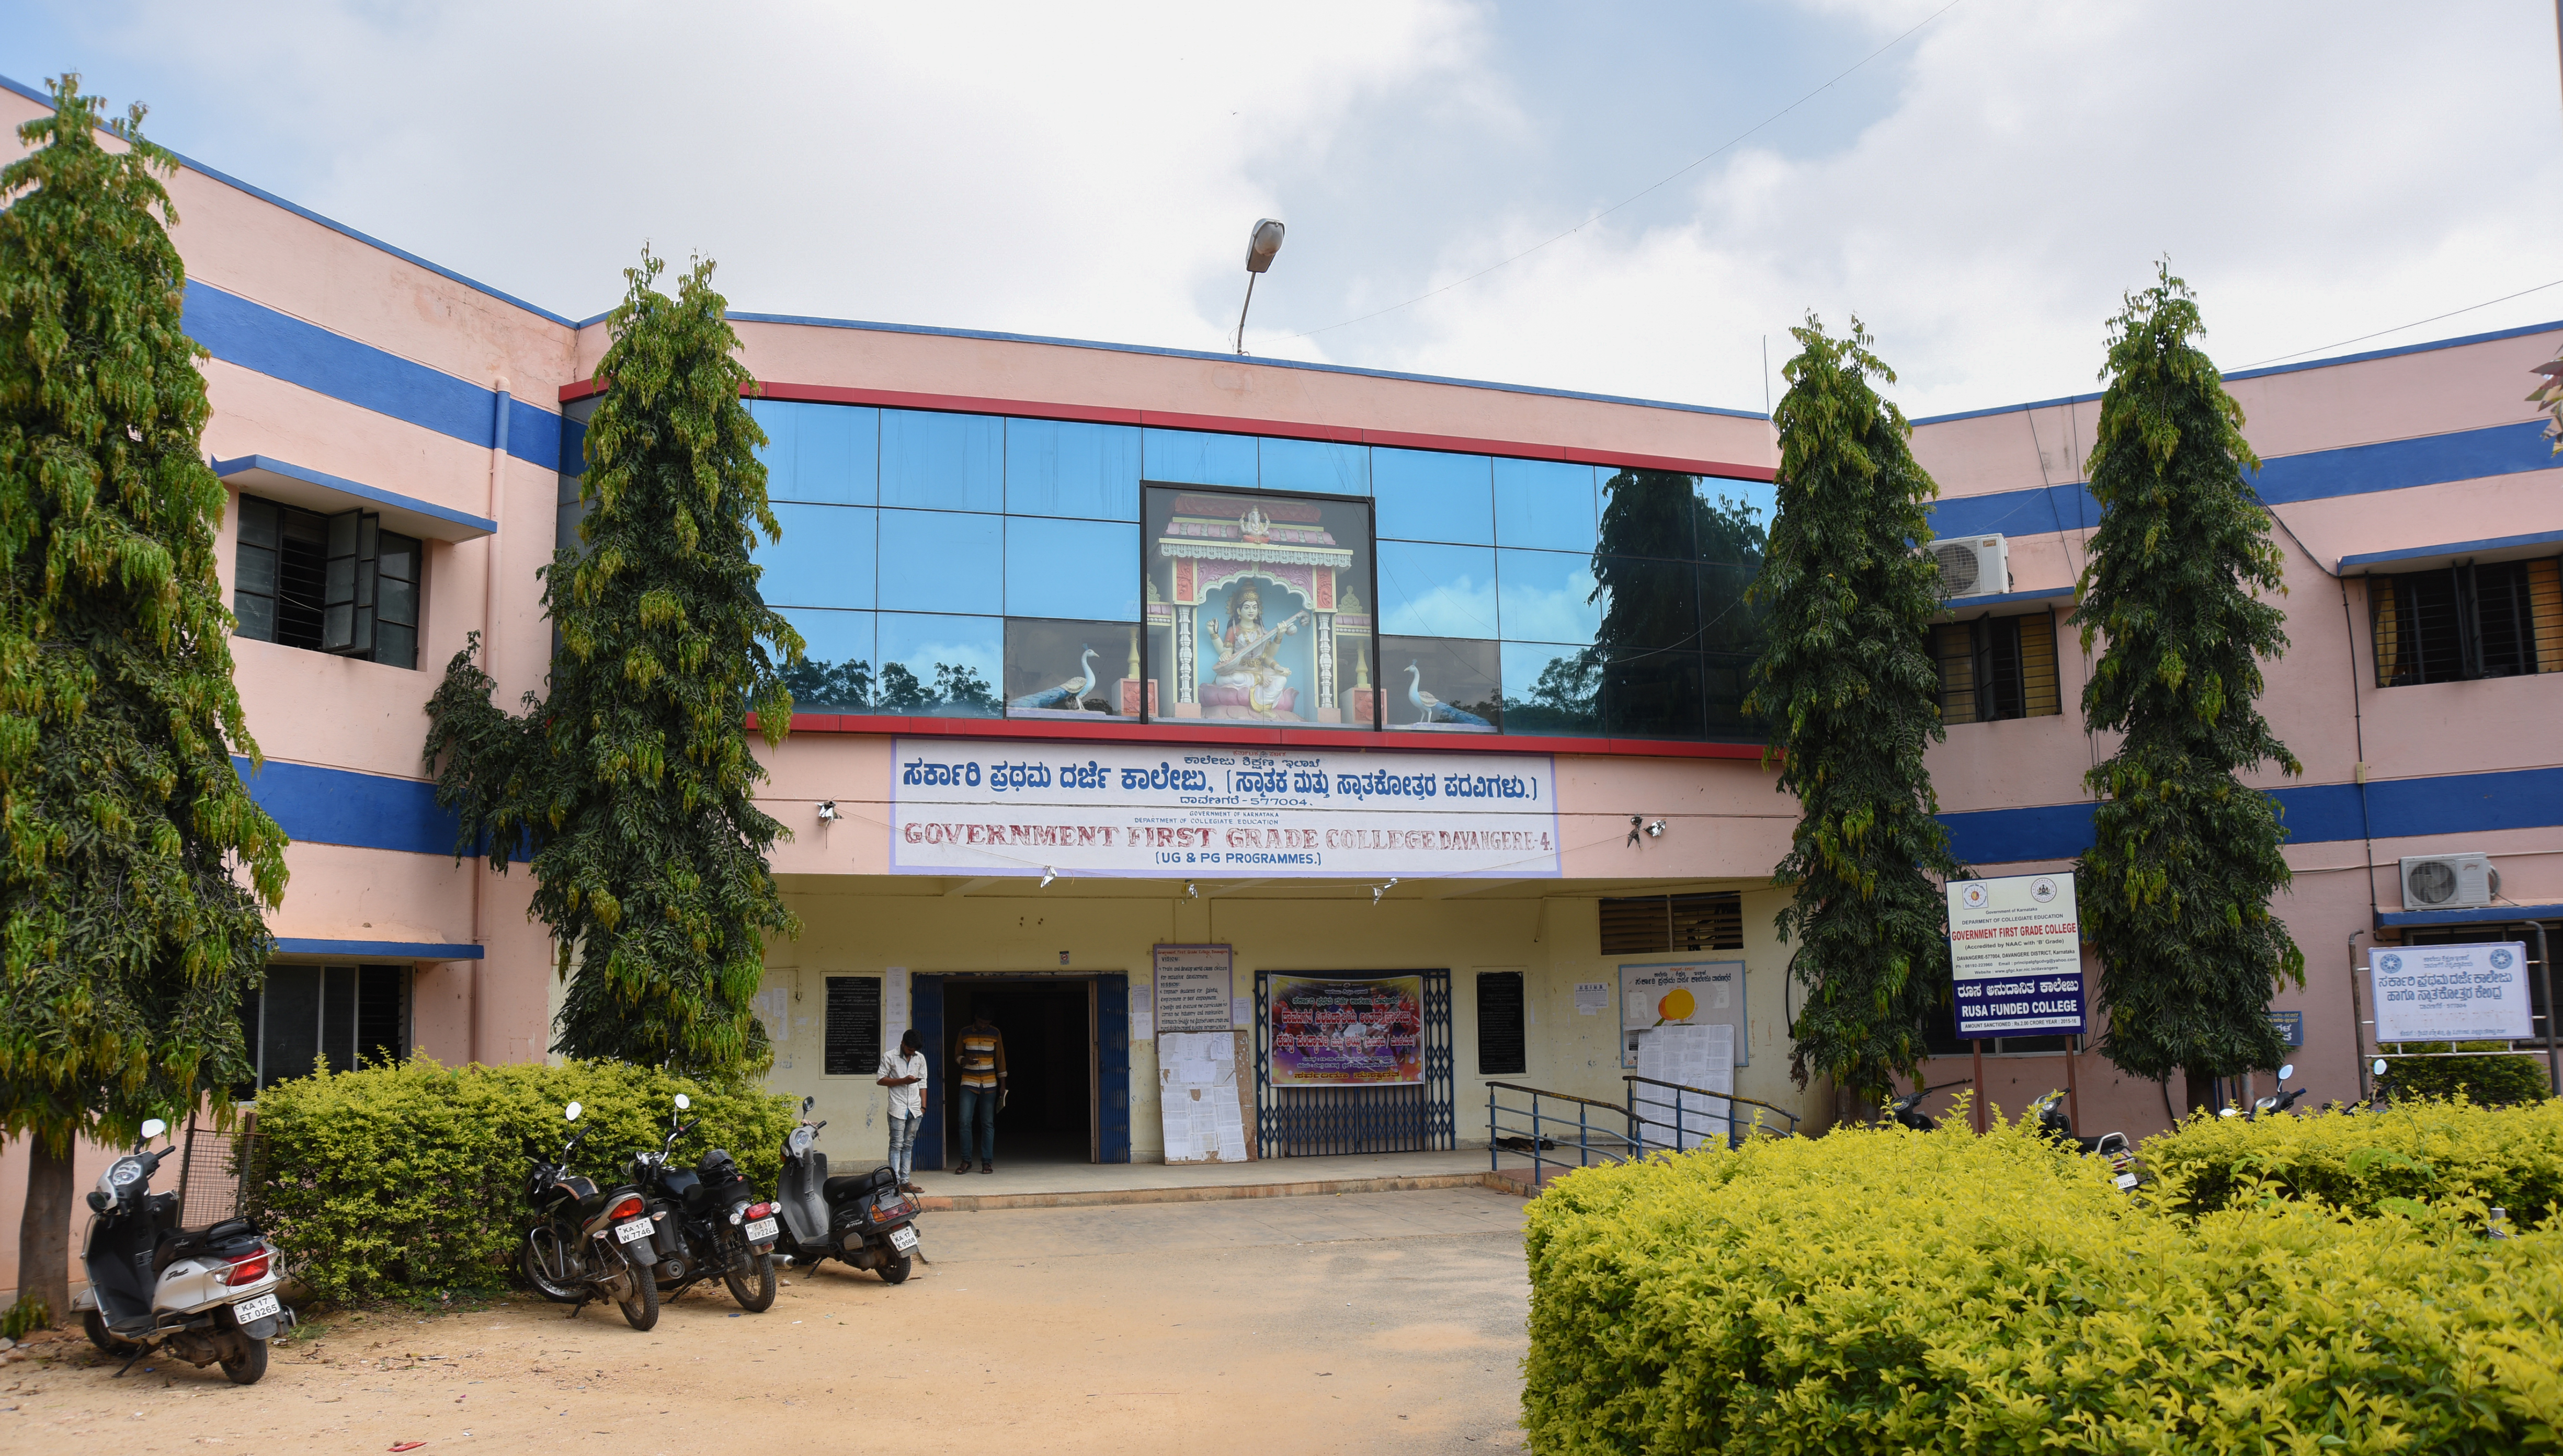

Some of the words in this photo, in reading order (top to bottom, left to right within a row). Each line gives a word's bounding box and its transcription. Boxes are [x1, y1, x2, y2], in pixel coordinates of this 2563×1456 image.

[1184, 755, 1235, 765] ಕಾಲೇಜು
[1243, 756, 1274, 769] ಶಿಕ್ಷಣ
[1282, 759, 1320, 768] ಇಲಾಖೆ
[903, 757, 981, 787] ಸರ್ಕಾರಿ
[990, 760, 1052, 792] ಪ್ರಥಮ
[1060, 761, 1111, 788] ದರ್ಜೆ
[1121, 762, 1213, 793] ಕಾಲೇಜು,
[1294, 769, 1330, 798] ಮತ್ತು
[1337, 769, 1437, 801] ಸ್ನಾತಕೋತ್ತರ
[904, 822, 1120, 847] GOVERNMENT
[1126, 826, 1217, 848] FIRST
[1225, 827, 1319, 849] GRADE
[1186, 852, 1196, 863] &
[1200, 853, 1220, 863] PG
[1952, 928, 1997, 941] GOVERNMENT
[1999, 927, 2018, 938] FIRST
[2020, 925, 2043, 936] GRADE
[2045, 923, 2076, 935] COLLEGE
[1635, 977, 1656, 985] ಸರ್ಕಾರಿ
[1658, 976, 1675, 986] ಪ್ರಥಮ
[2378, 976, 2415, 987] ಸರ್ಕಾರಿ
[2417, 974, 2448, 987] ಪ್ರಥಮ
[2450, 971, 2473, 984] ದರ್ಜೆ
[2473, 970, 2512, 983] ಕಾಲೇಜು
[1957, 983, 1981, 998] ರೂಸ
[1987, 979, 2035, 996] ಅನುದಾನಿತ
[2040, 978, 2079, 993] ಕಾಲೇಜು
[2387, 989, 2415, 1001] ಹಾಗೂ
[2417, 986, 2473, 1002] ಸ್ನಾತಕೋತ್ತರ
[1292, 996, 1315, 1005] ಸರ್ಕಾರಿ
[1316, 997, 1333, 1006] ಪ್ರಥಮ
[1962, 1004, 1988, 1017] RUSA
[1990, 1002, 2029, 1016] FUNDED
[2032, 1000, 2077, 1013] COLLEGE
[1315, 1009, 1357, 1030] ವಿಶ್ವವಿದ್ಯಾಲಯ
[1385, 1008, 1411, 1024] ಕಾಲೇಜು
[1277, 1031, 1294, 1053] ಕಬಡ್ಡಿ
[1296, 1031, 1329, 1054] ಪಂದ್ಯಾವಳಿ
[1331, 1036, 1343, 1051] ಮತ್ತು
[1353, 1070, 1400, 1080] ಸುಸ್ವಾಗತ
[631, 1228, 651, 1239] 7746
[845, 1221, 863, 1230] Activa
[902, 1237, 916, 1248] 9568
[240, 1312, 251, 1322] ET
[255, 1304, 277, 1317] 0265
[241, 1303, 256, 1312] KA
[258, 1298, 268, 1306] 17
